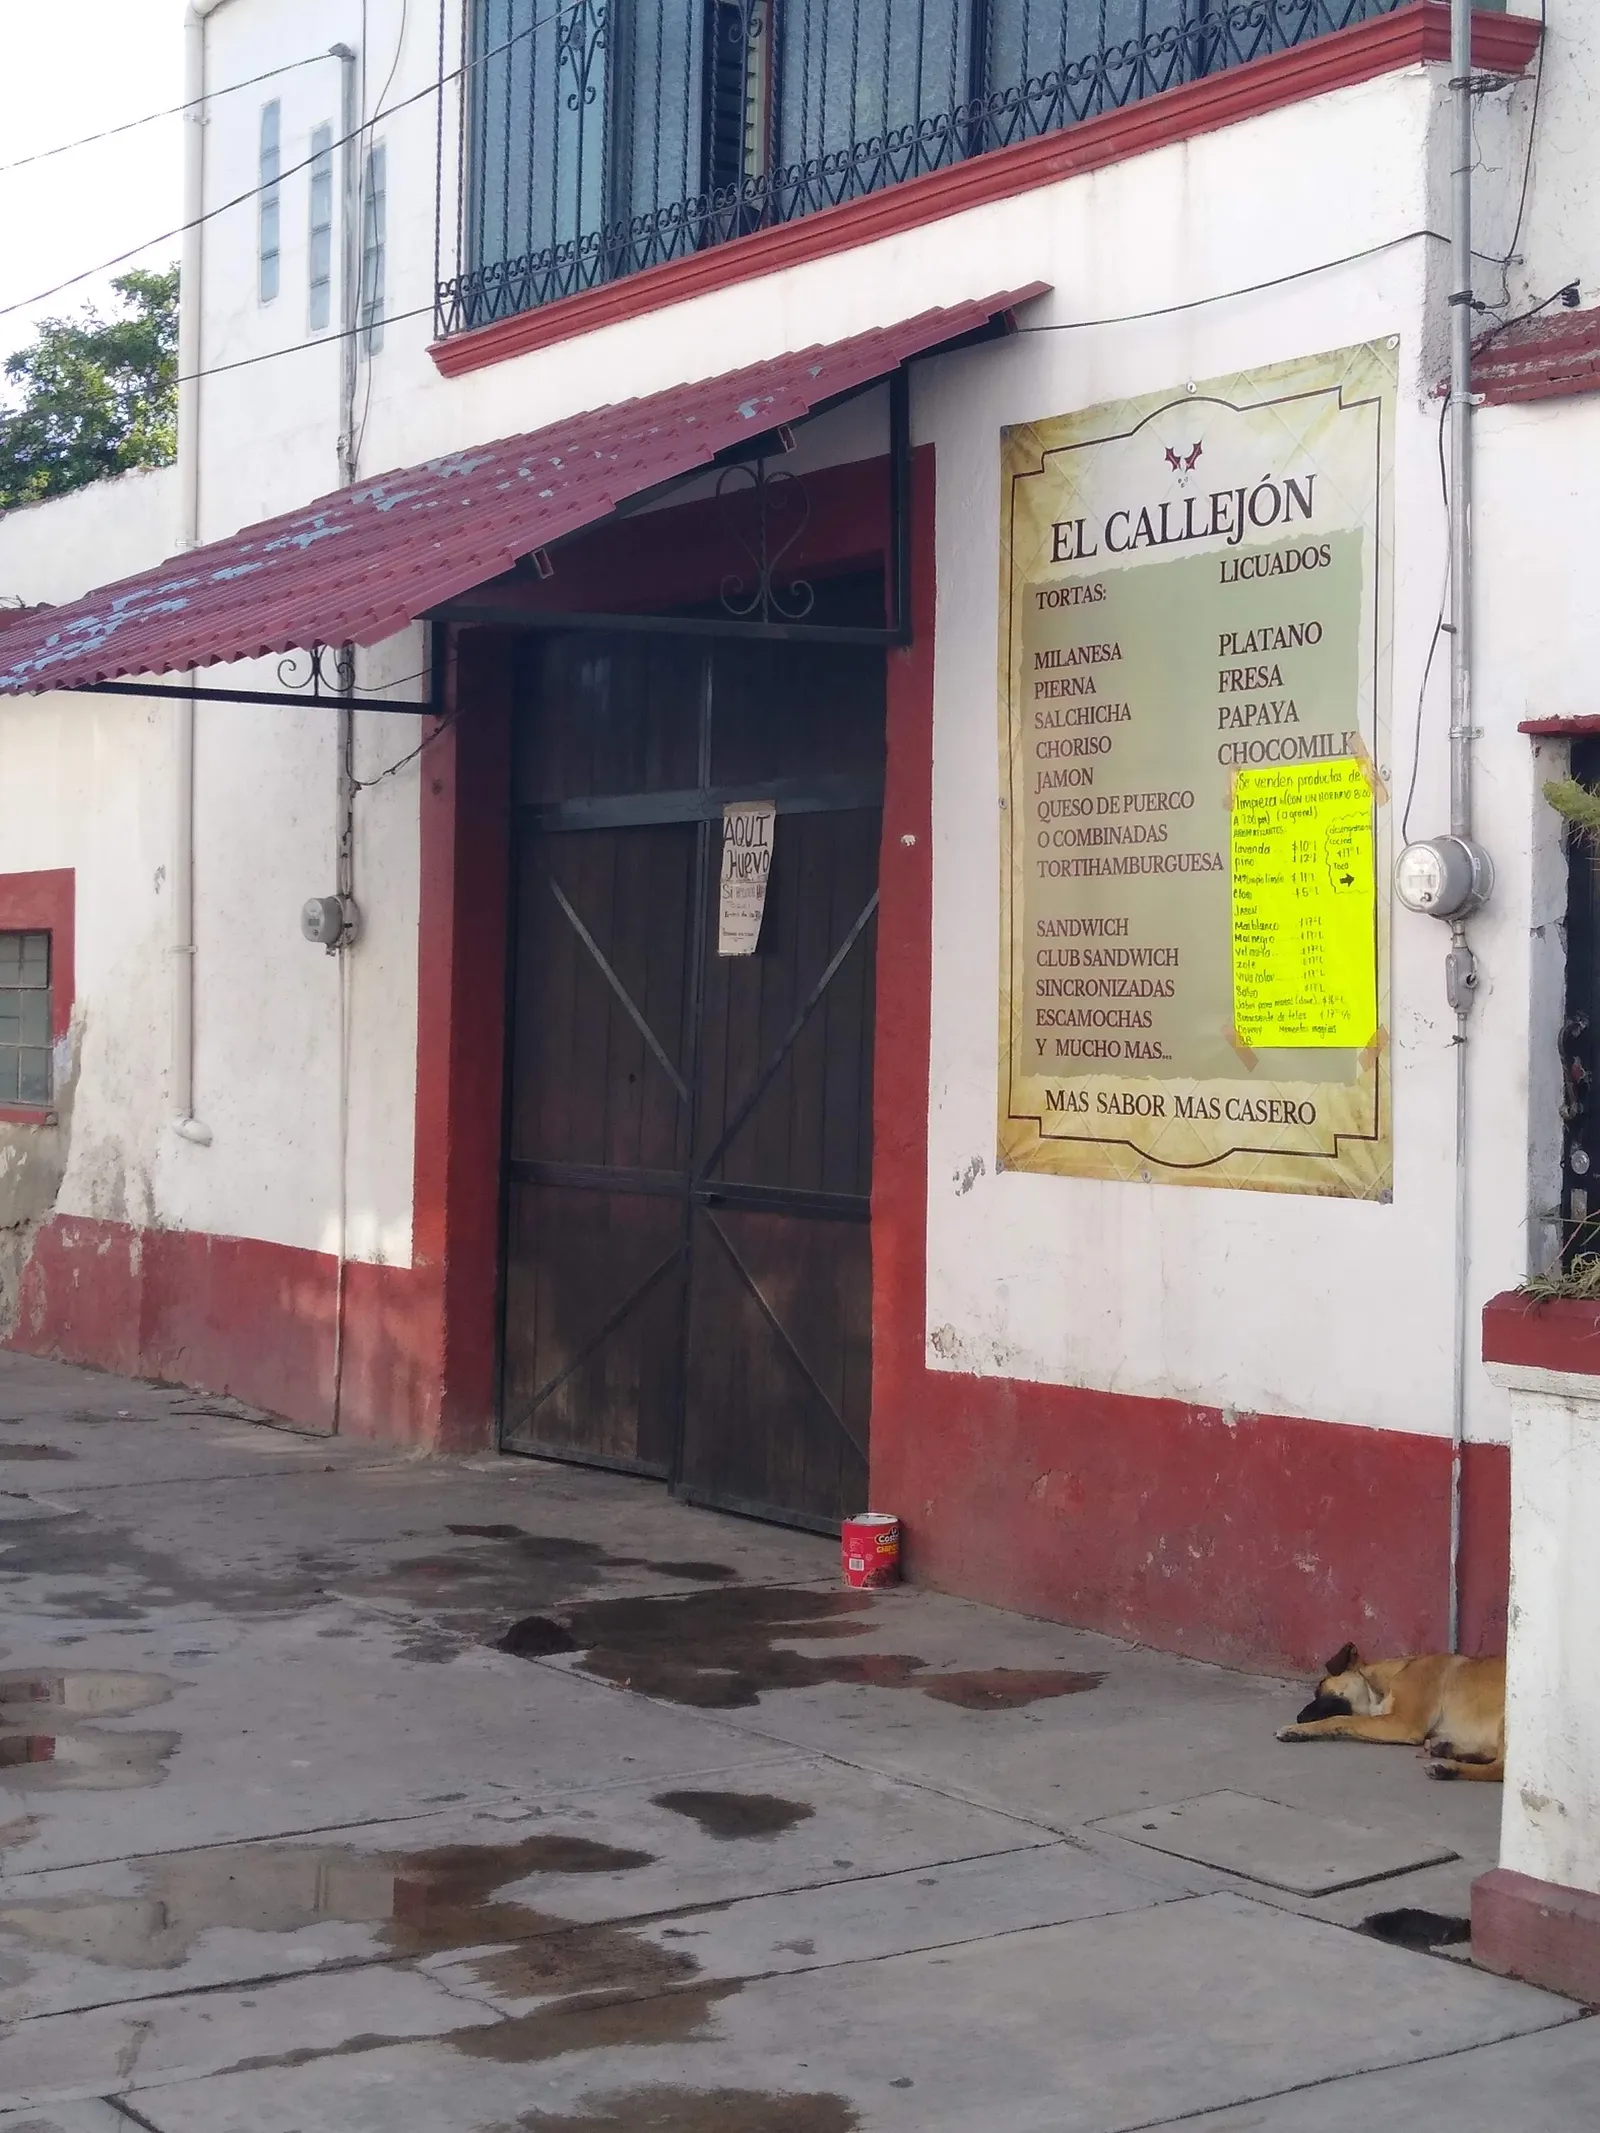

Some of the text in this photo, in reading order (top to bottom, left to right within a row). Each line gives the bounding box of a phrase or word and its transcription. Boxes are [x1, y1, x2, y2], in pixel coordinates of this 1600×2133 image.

[1050, 473, 1317, 563] EL CALLEJÓN
[1219, 544, 1332, 583] LICUADOS
[1036, 583, 1107, 610] TORTAS:
[1218, 621, 1323, 657] PLATANO
[1034, 642, 1123, 670] MILANESA
[1034, 676, 1096, 700] PIERNA
[1218, 663, 1285, 693] FRESA
[1034, 703, 1132, 729] SALCHICHA
[1217, 699, 1300, 730] PAPAYA
[1036, 735, 1112, 759] CHORISO
[1217, 731, 1357, 766] CHOCOMILK
[1034, 767, 1094, 794] JAMON
[1254, 772, 1293, 788] venden
[1297, 768, 1342, 793] productos
[1348, 769, 1361, 783] de
[1037, 790, 1195, 823] QUESO DE PUERCO
[724, 814, 771, 848] AQUI
[1037, 824, 1168, 848] O COMBINADAS
[1037, 852, 1225, 878] TORTIHAMBURGUESA
[1036, 917, 1129, 938] SANDWICH
[1036, 948, 1179, 967] CLUB SANDWICH
[1036, 979, 1175, 998] SINCRONIZADAS
[1036, 1008, 1153, 1028] ESCAMOCHAS
[1035, 1038, 1047, 1056] Y
[1055, 1038, 1121, 1058] MUCHO
[1045, 1089, 1316, 1125] MAS SABOR MAS CASERO
